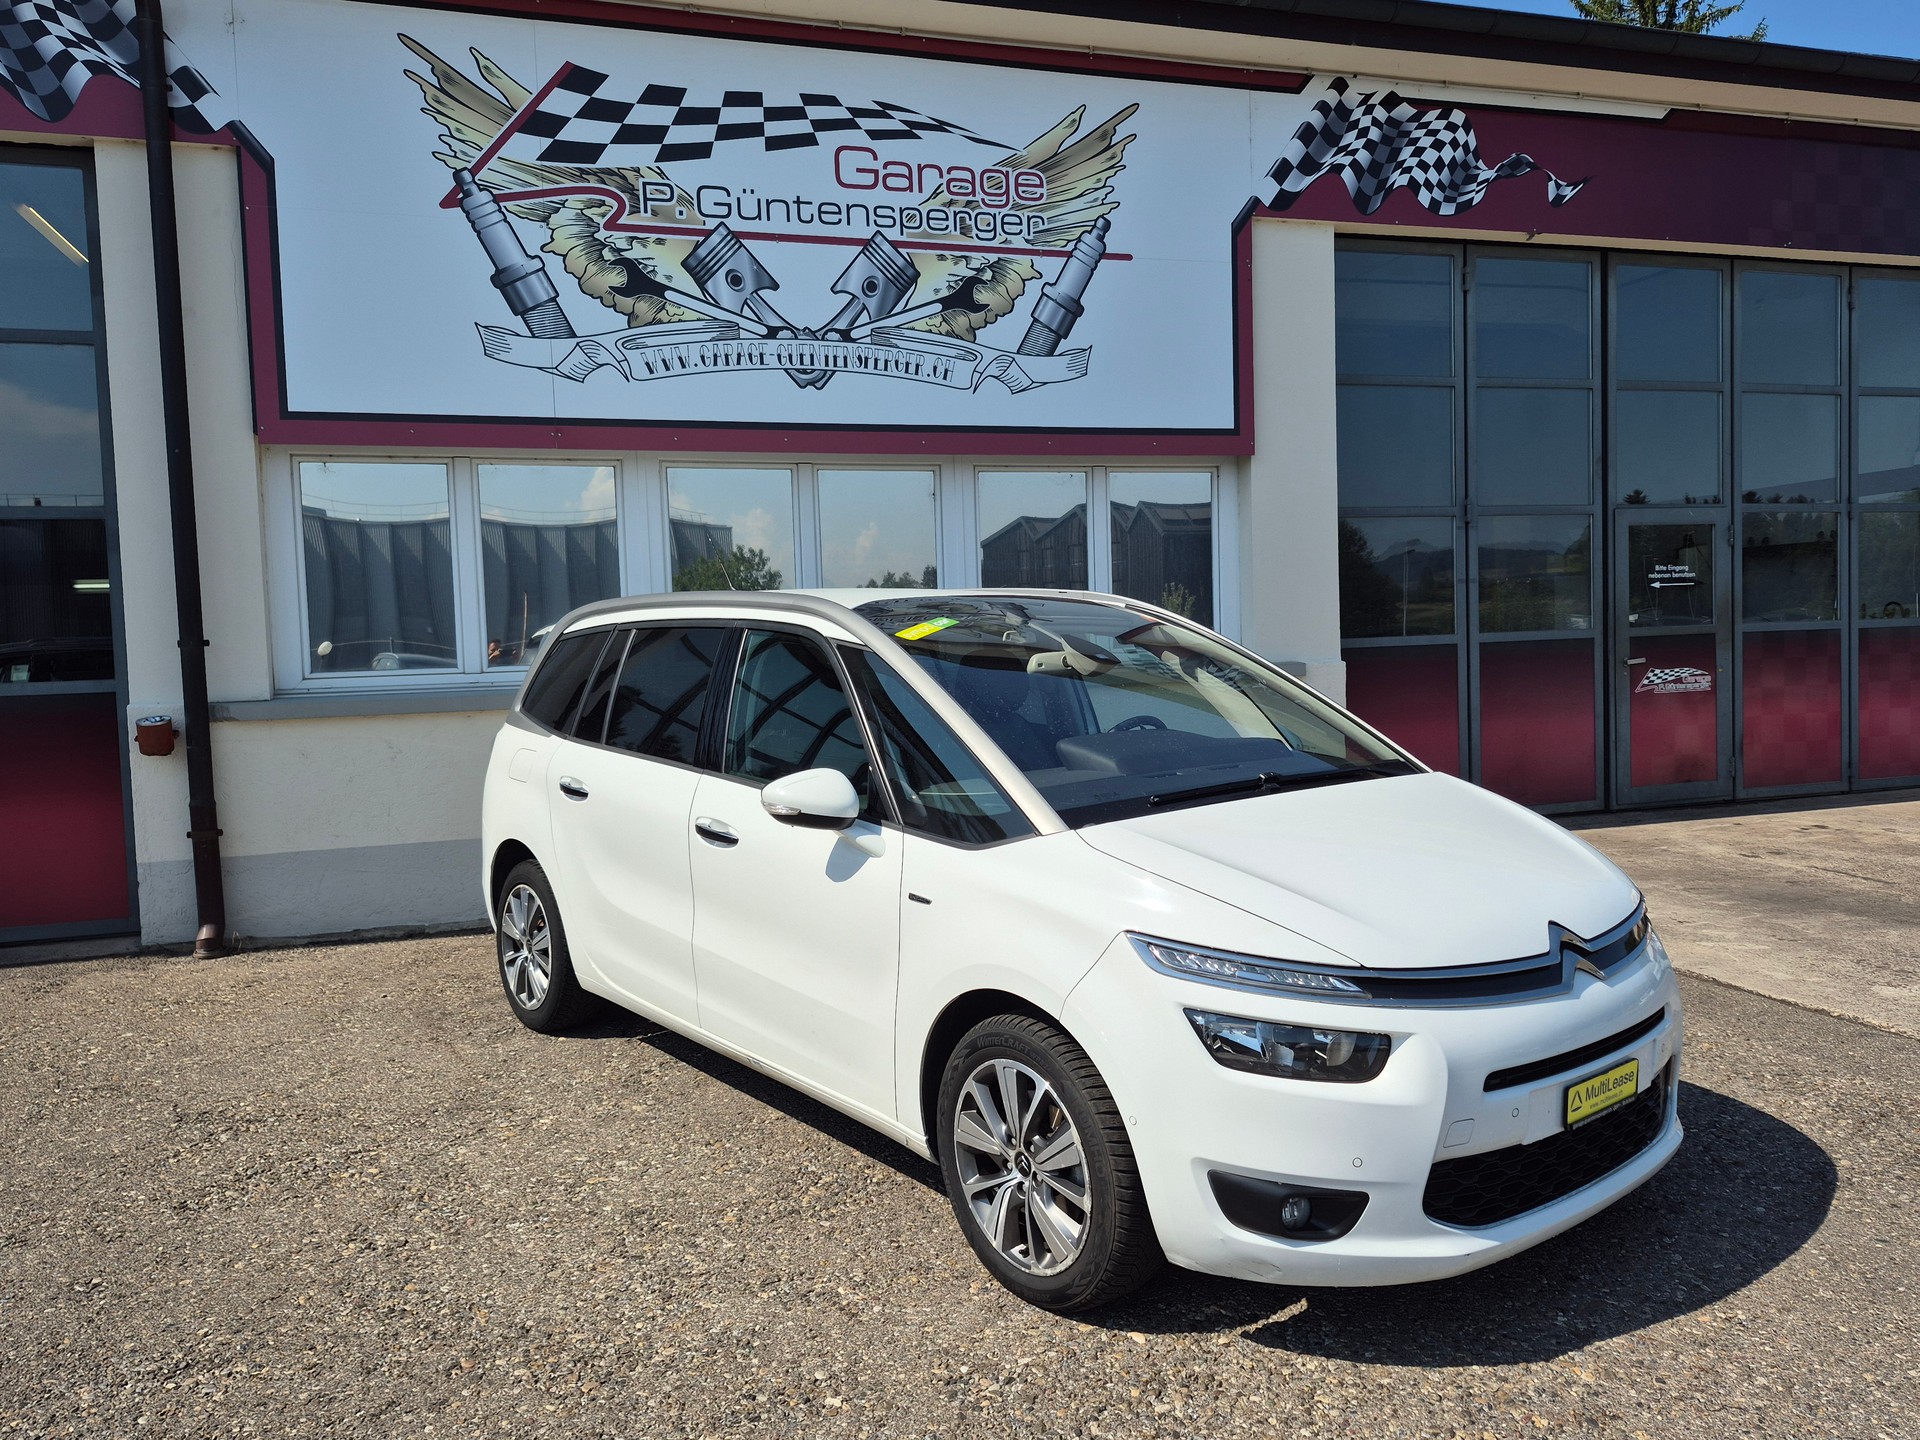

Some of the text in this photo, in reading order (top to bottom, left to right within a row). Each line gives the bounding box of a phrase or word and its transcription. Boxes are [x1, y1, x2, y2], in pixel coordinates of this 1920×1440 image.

[834, 145, 1046, 208] Garage
[696, 186, 1046, 241] Güntensperger
[641, 343, 955, 382] WWW.GARAGE-GUENTENSPERGER.CH
[1585, 1070, 1635, 1102] MultiLease
